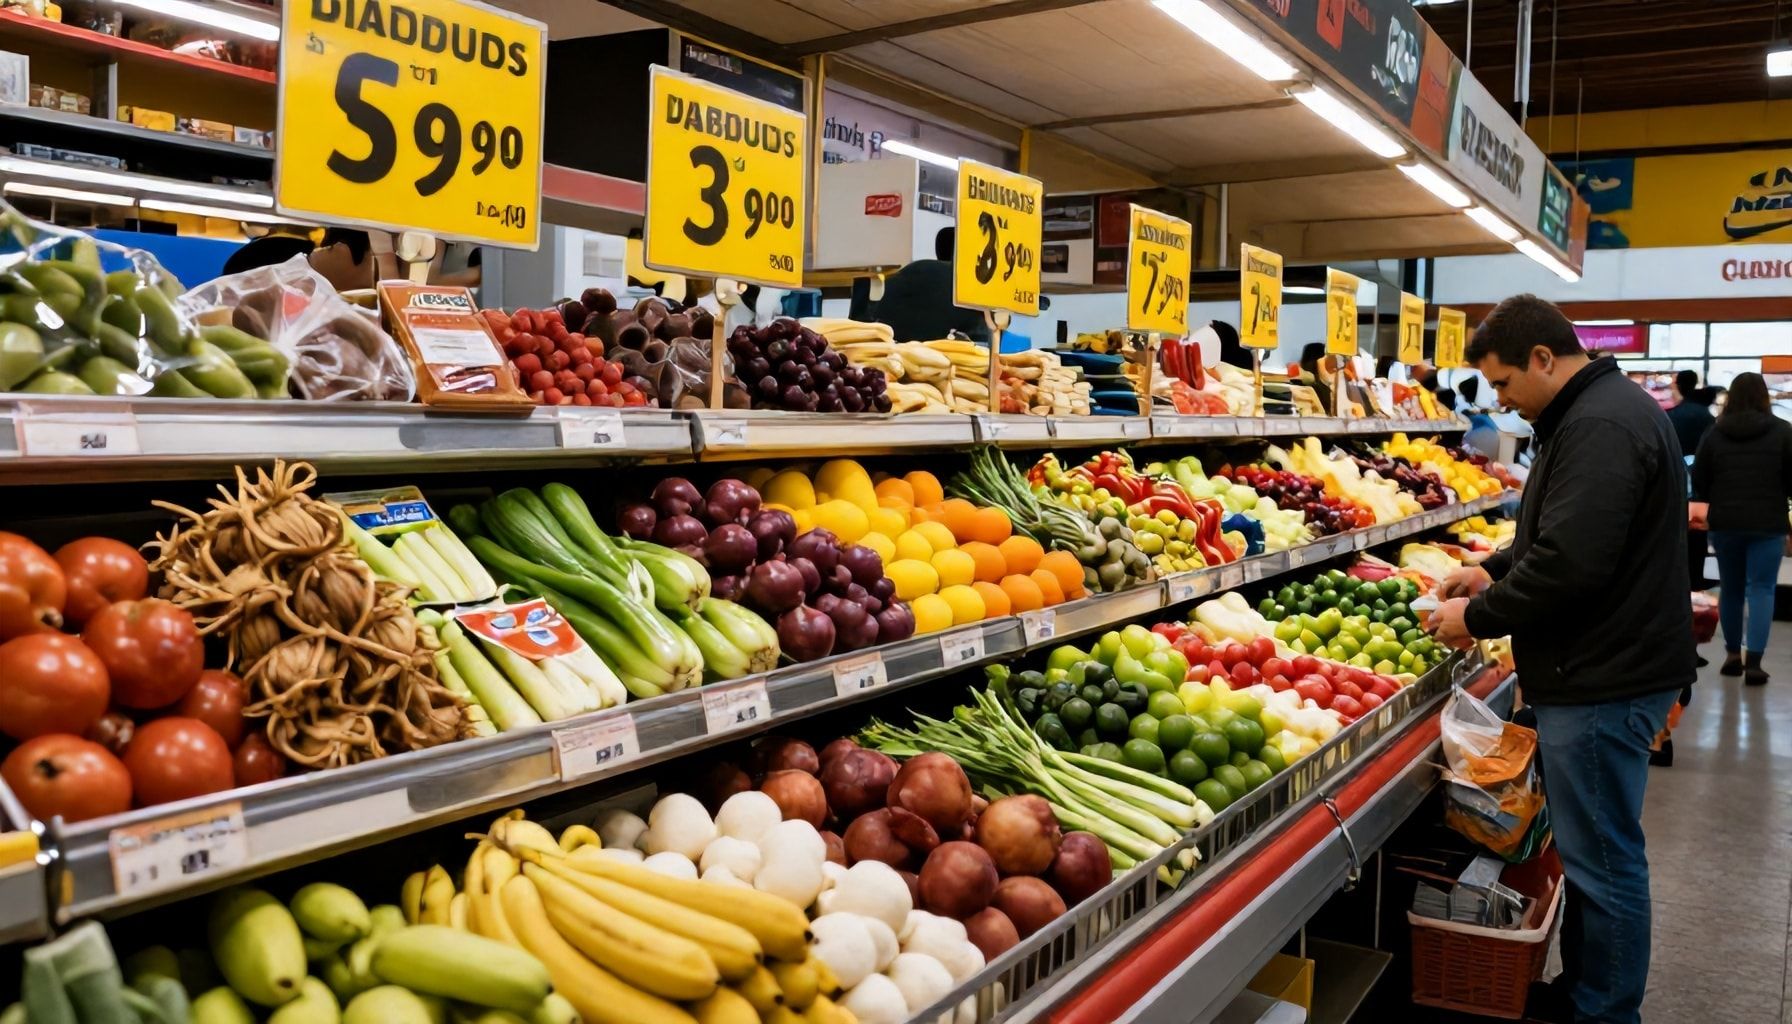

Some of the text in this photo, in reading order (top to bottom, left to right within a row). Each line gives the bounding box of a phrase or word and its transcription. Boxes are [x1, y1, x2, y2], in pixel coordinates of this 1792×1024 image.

[326, 52, 399, 184] 5
[683, 144, 794, 247] 3 900
